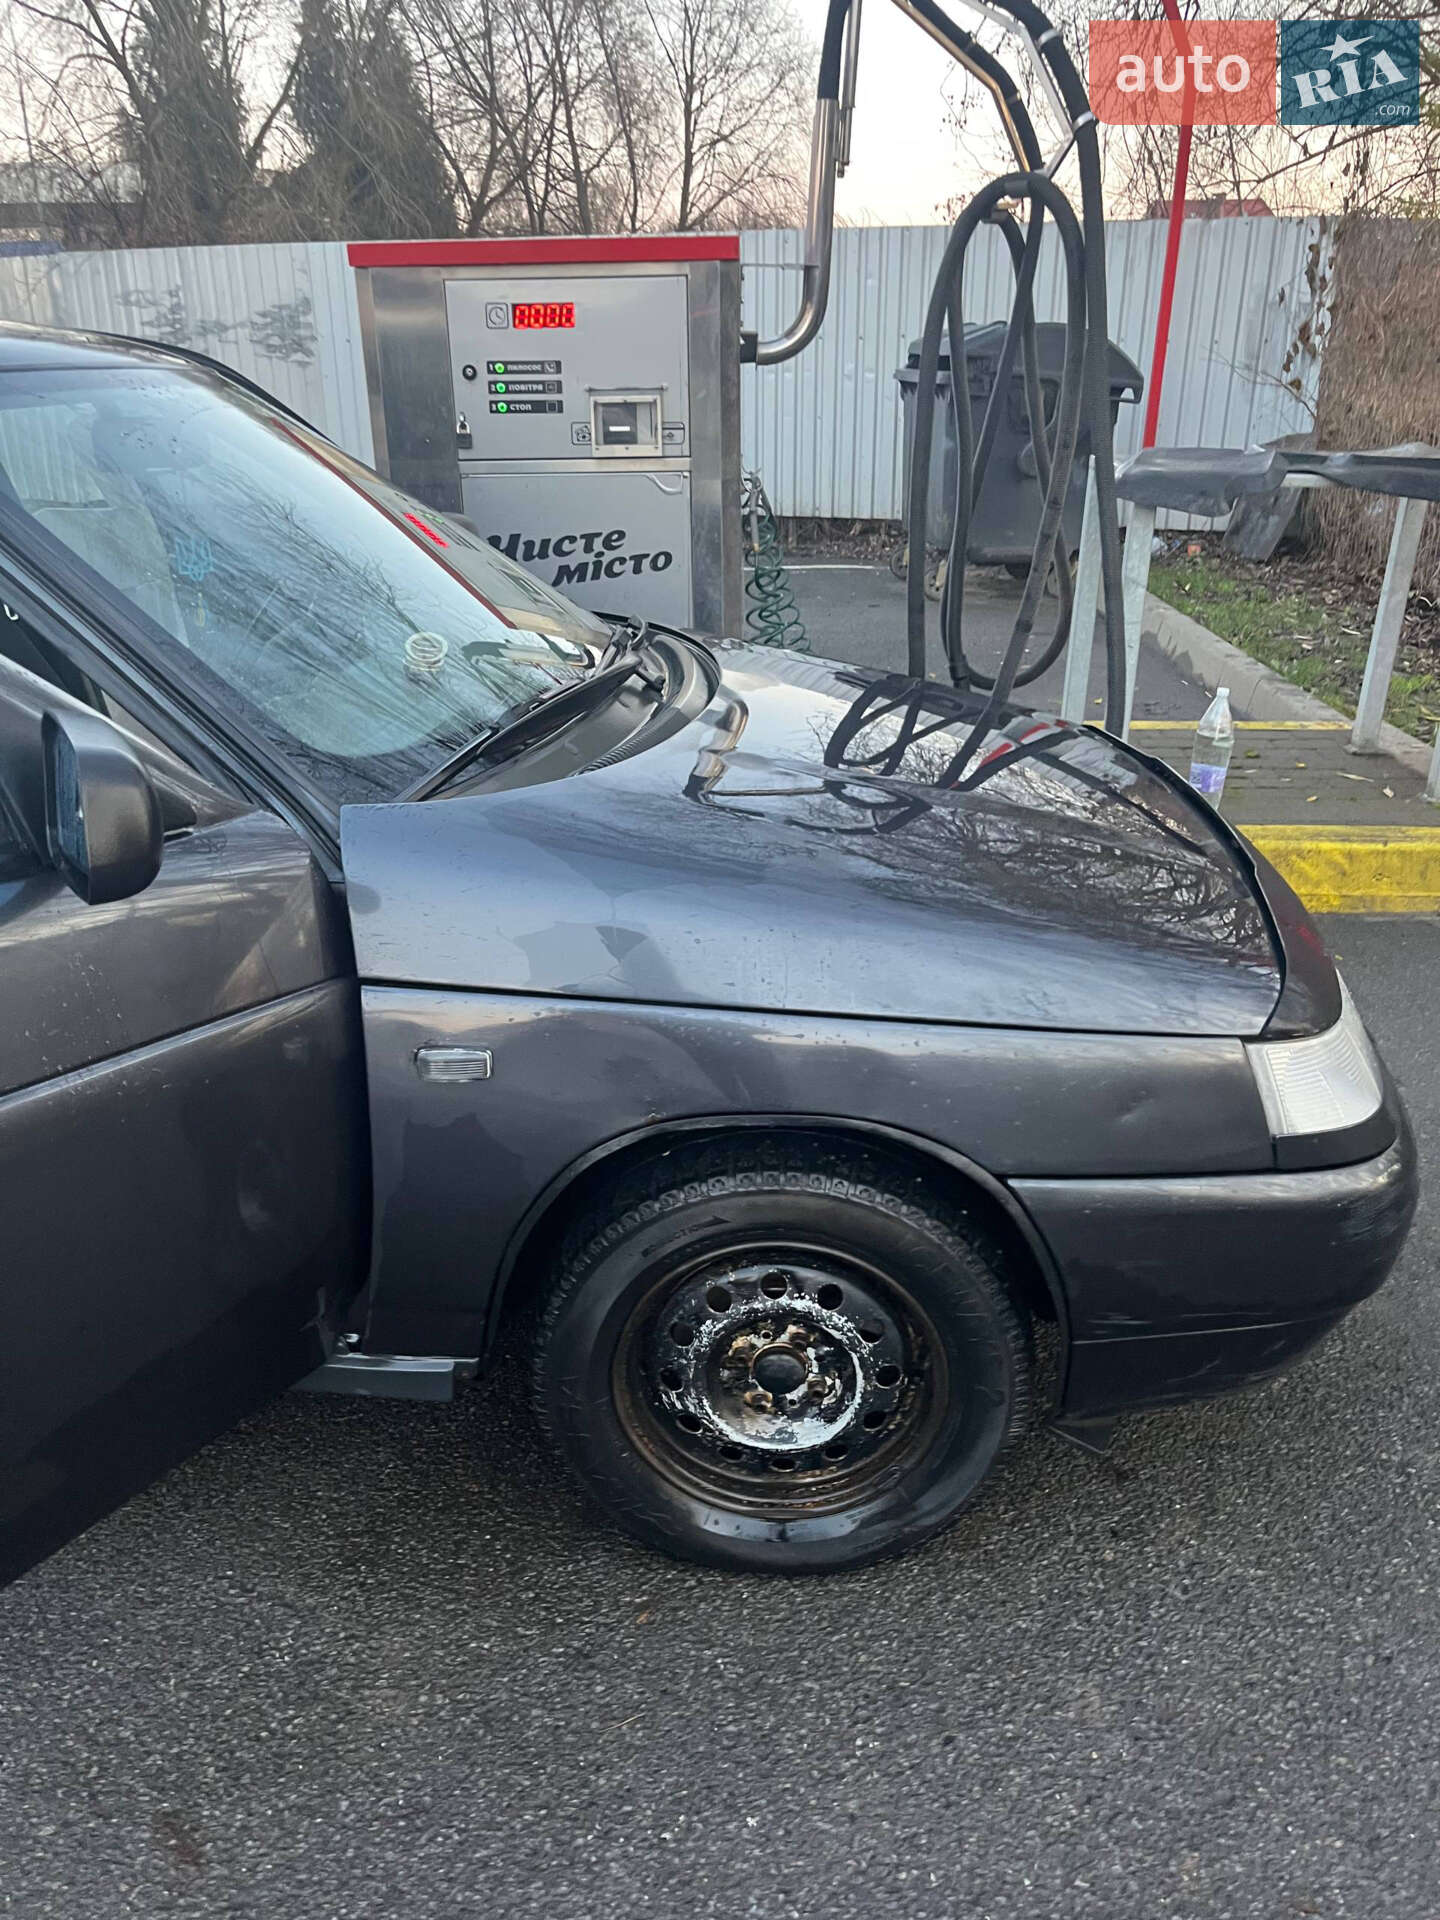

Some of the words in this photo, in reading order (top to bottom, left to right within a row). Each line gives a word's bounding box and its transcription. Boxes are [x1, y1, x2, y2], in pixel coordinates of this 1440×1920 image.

[510, 403, 532, 411] СТОП
[486, 529, 626, 562] Чисте
[551, 550, 673, 587] місто
